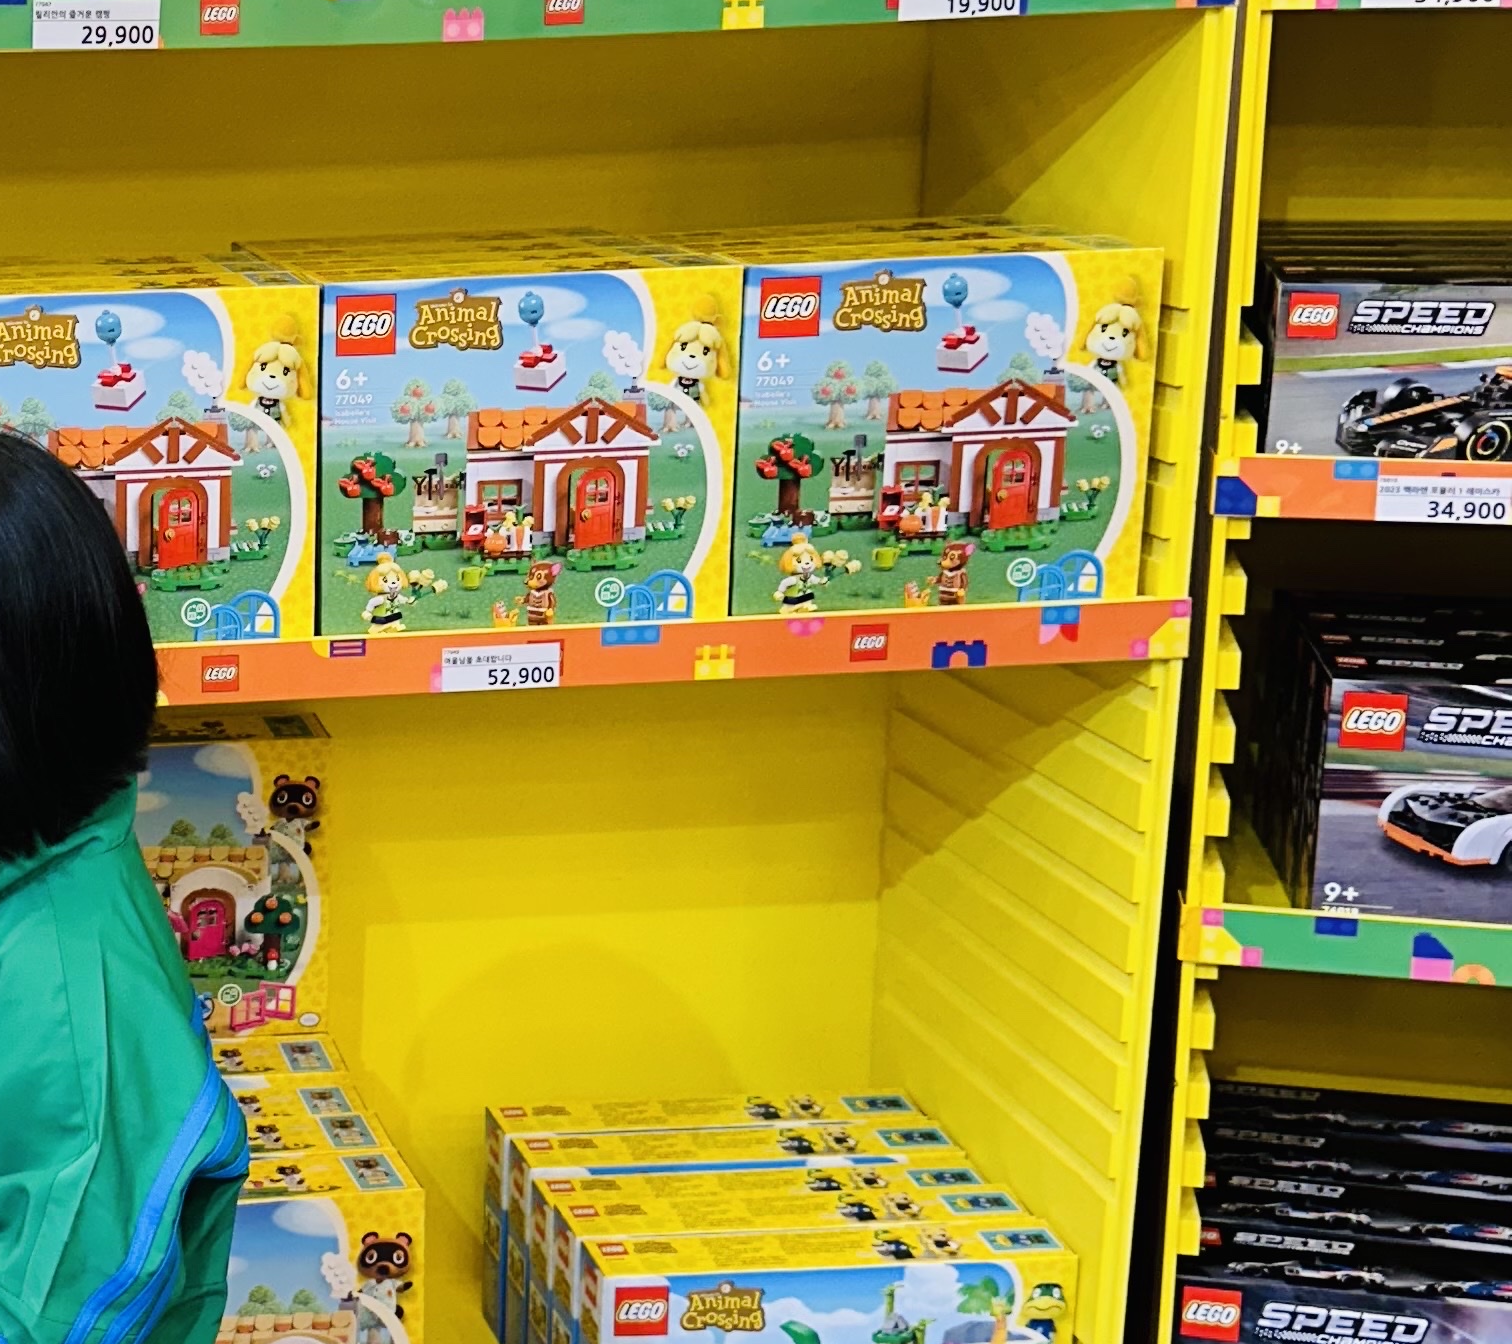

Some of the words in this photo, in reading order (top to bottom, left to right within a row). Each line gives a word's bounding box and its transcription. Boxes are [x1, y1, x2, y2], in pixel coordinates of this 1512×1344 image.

[203, 6, 237, 24] LEGO
[82, 26, 154, 47] 29,900
[845, 283, 921, 307] Animal
[420, 302, 496, 325] Animal
[765, 295, 816, 318] LEGO
[836, 305, 924, 328] Crossing
[1292, 306, 1336, 324] LEGO
[1351, 301, 1494, 324] SPEED
[340, 314, 392, 337] LEGO
[412, 323, 501, 347] Crossing
[757, 351, 790, 371] 6+
[336, 369, 368, 389] 6+
[756, 376, 794, 386] 77049
[335, 394, 372, 404] 77049
[1276, 440, 1302, 454] 9+
[1428, 501, 1505, 521] 34,900
[853, 634, 885, 650] LEGO
[204, 666, 236, 681] LEGO
[488, 667, 554, 687] 52,900
[1323, 883, 1359, 902] 9+
[618, 1301, 665, 1321] LEGO
[690, 1291, 760, 1311] Animal
[682, 1309, 763, 1329] Crossing
[1185, 1303, 1238, 1324] LEGO
[1258, 1301, 1429, 1342] SPEED
